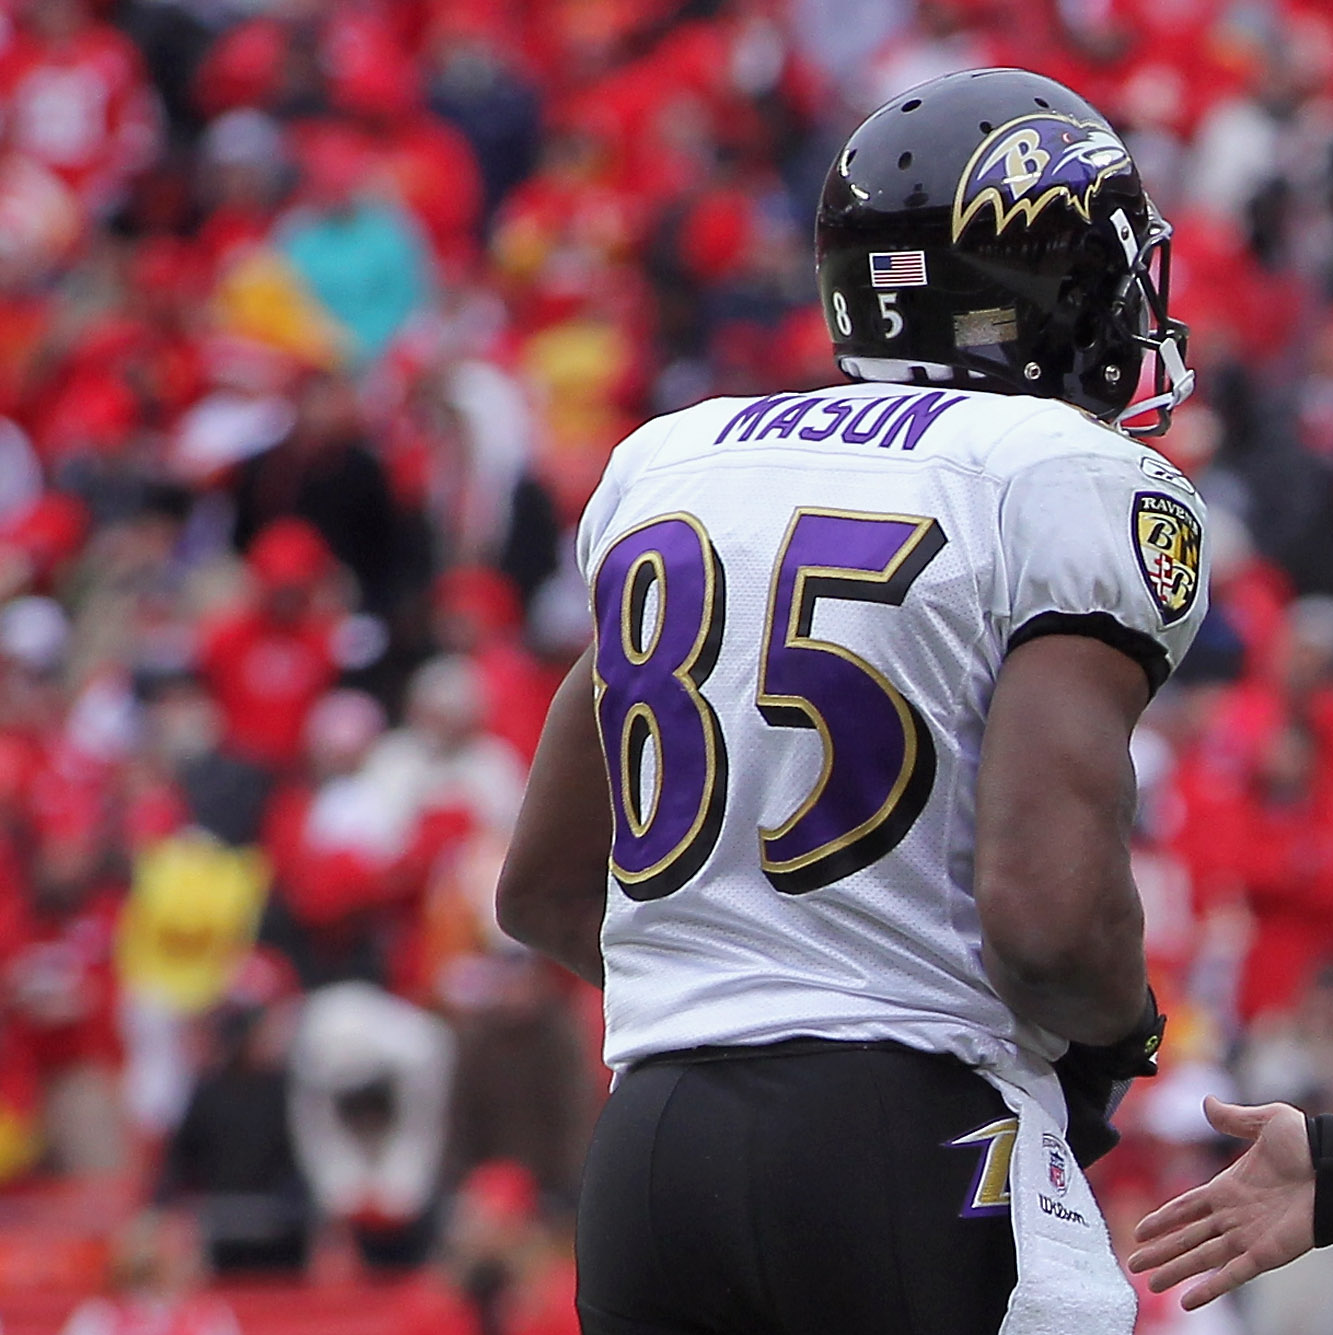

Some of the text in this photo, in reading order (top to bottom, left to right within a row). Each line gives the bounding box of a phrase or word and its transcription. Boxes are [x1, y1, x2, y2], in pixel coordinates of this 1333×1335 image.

[977, 128, 1051, 200] B
[712, 390, 971, 451] MASON
[589, 505, 950, 903] 85
[1037, 1192, 1091, 1229] Wilson
